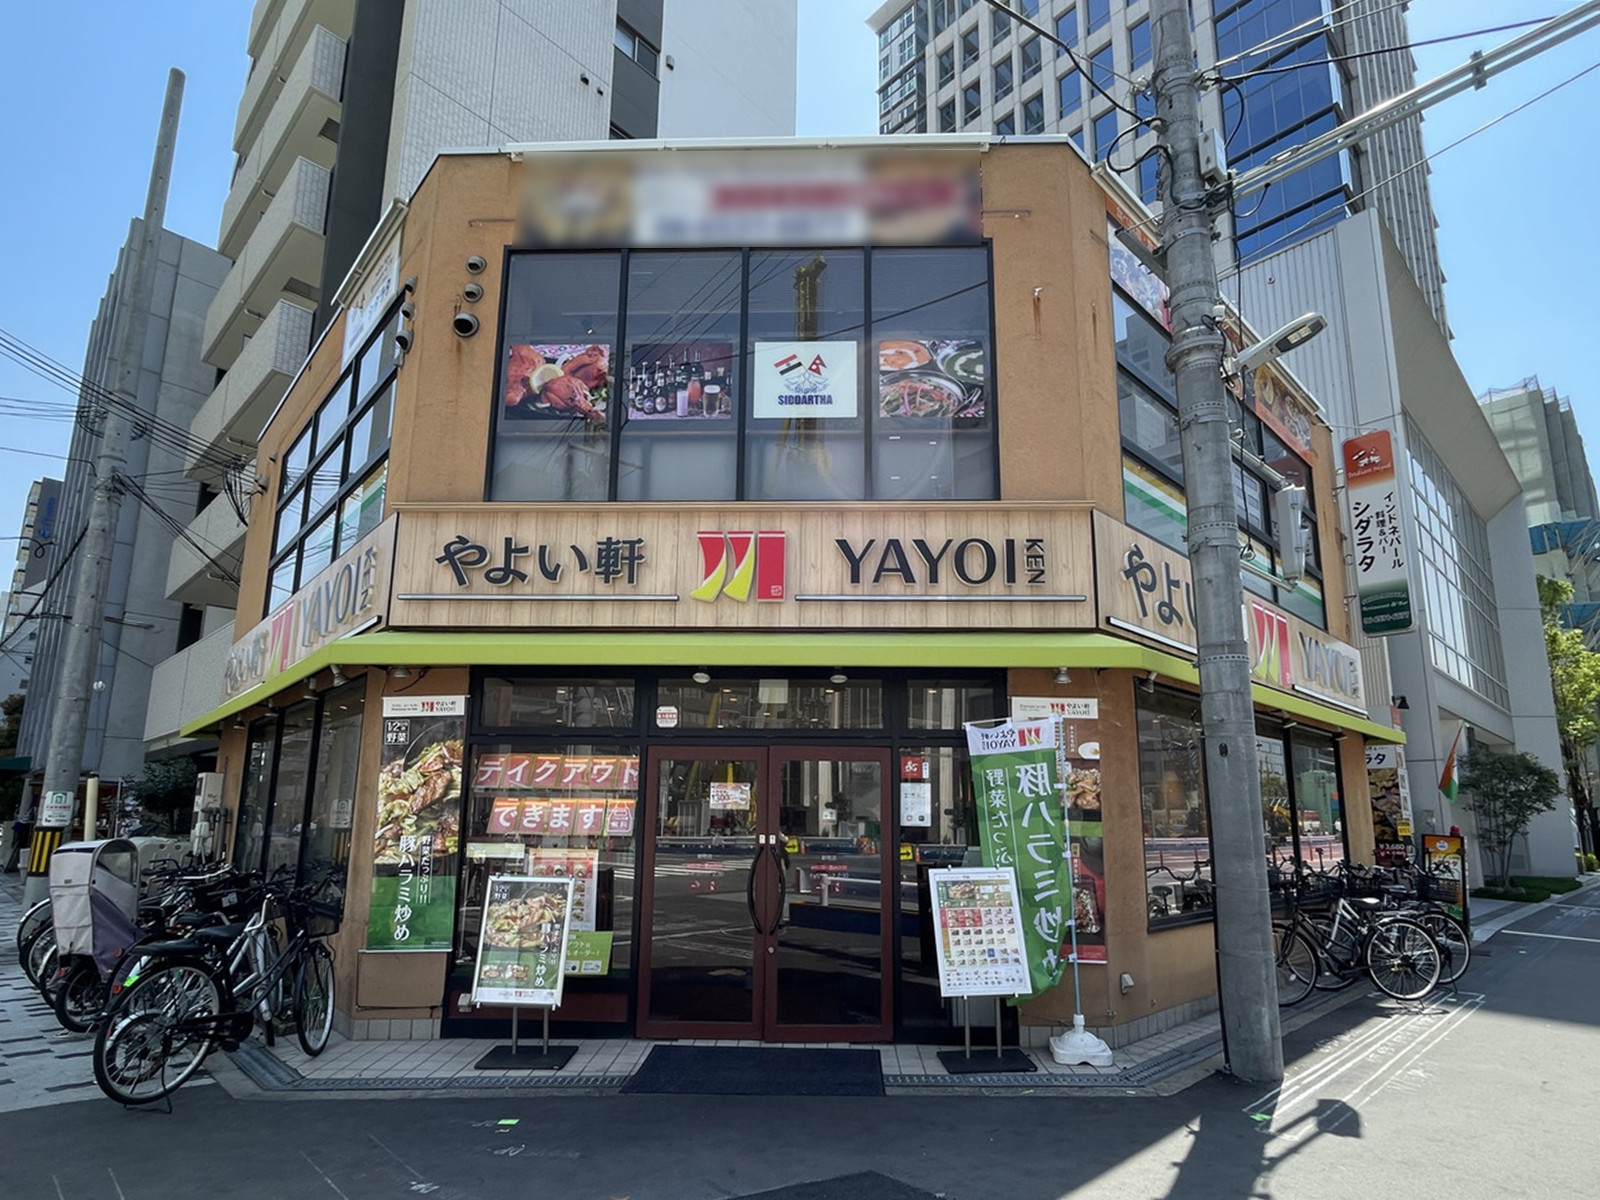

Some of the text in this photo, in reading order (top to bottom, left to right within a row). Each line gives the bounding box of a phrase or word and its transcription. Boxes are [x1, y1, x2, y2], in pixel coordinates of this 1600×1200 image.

[778, 395, 833, 405] SIDDARTHA
[1353, 501, 1376, 573] シダラタ
[435, 535, 645, 586] やよい軒
[834, 538, 1045, 584] YAYOI KEN
[479, 759, 639, 784] テイクアウト
[494, 803, 603, 829] できます
[394, 835, 417, 940] 豚ハラミ炒め
